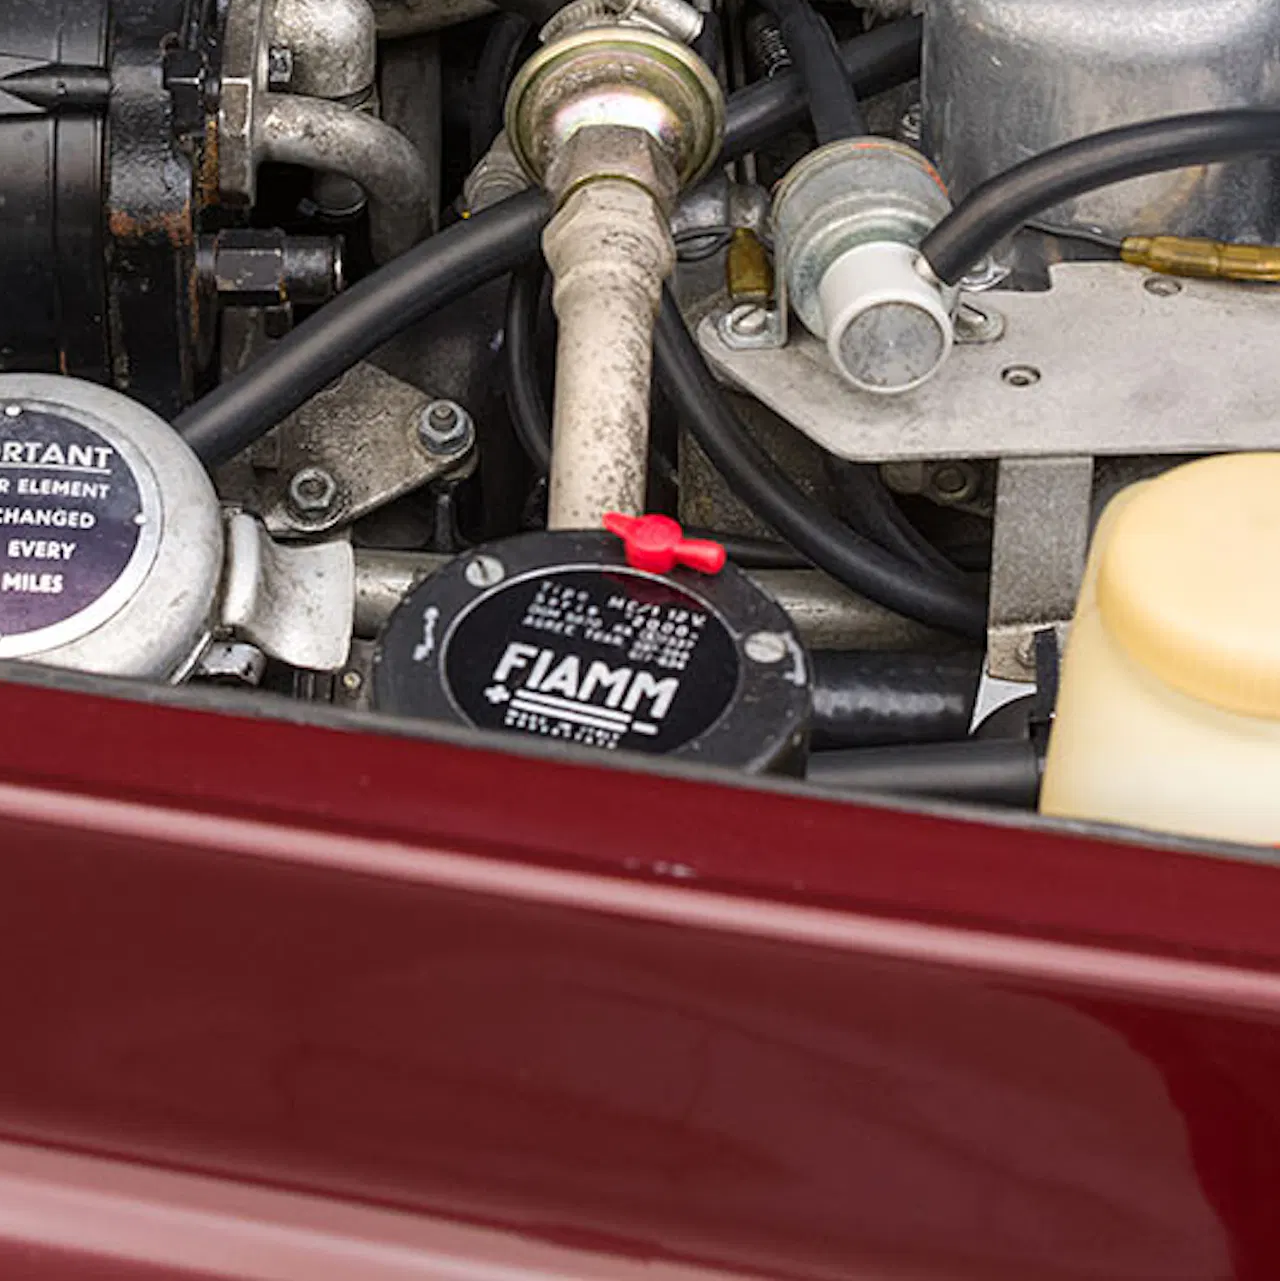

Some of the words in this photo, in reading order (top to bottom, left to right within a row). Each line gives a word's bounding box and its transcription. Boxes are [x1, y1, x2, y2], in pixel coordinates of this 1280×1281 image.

[17, 478, 111, 500] ELEMENT
[7, 539, 77, 561] EVERY
[0, 571, 64, 595] MILES
[491, 640, 681, 720] FIAMM
